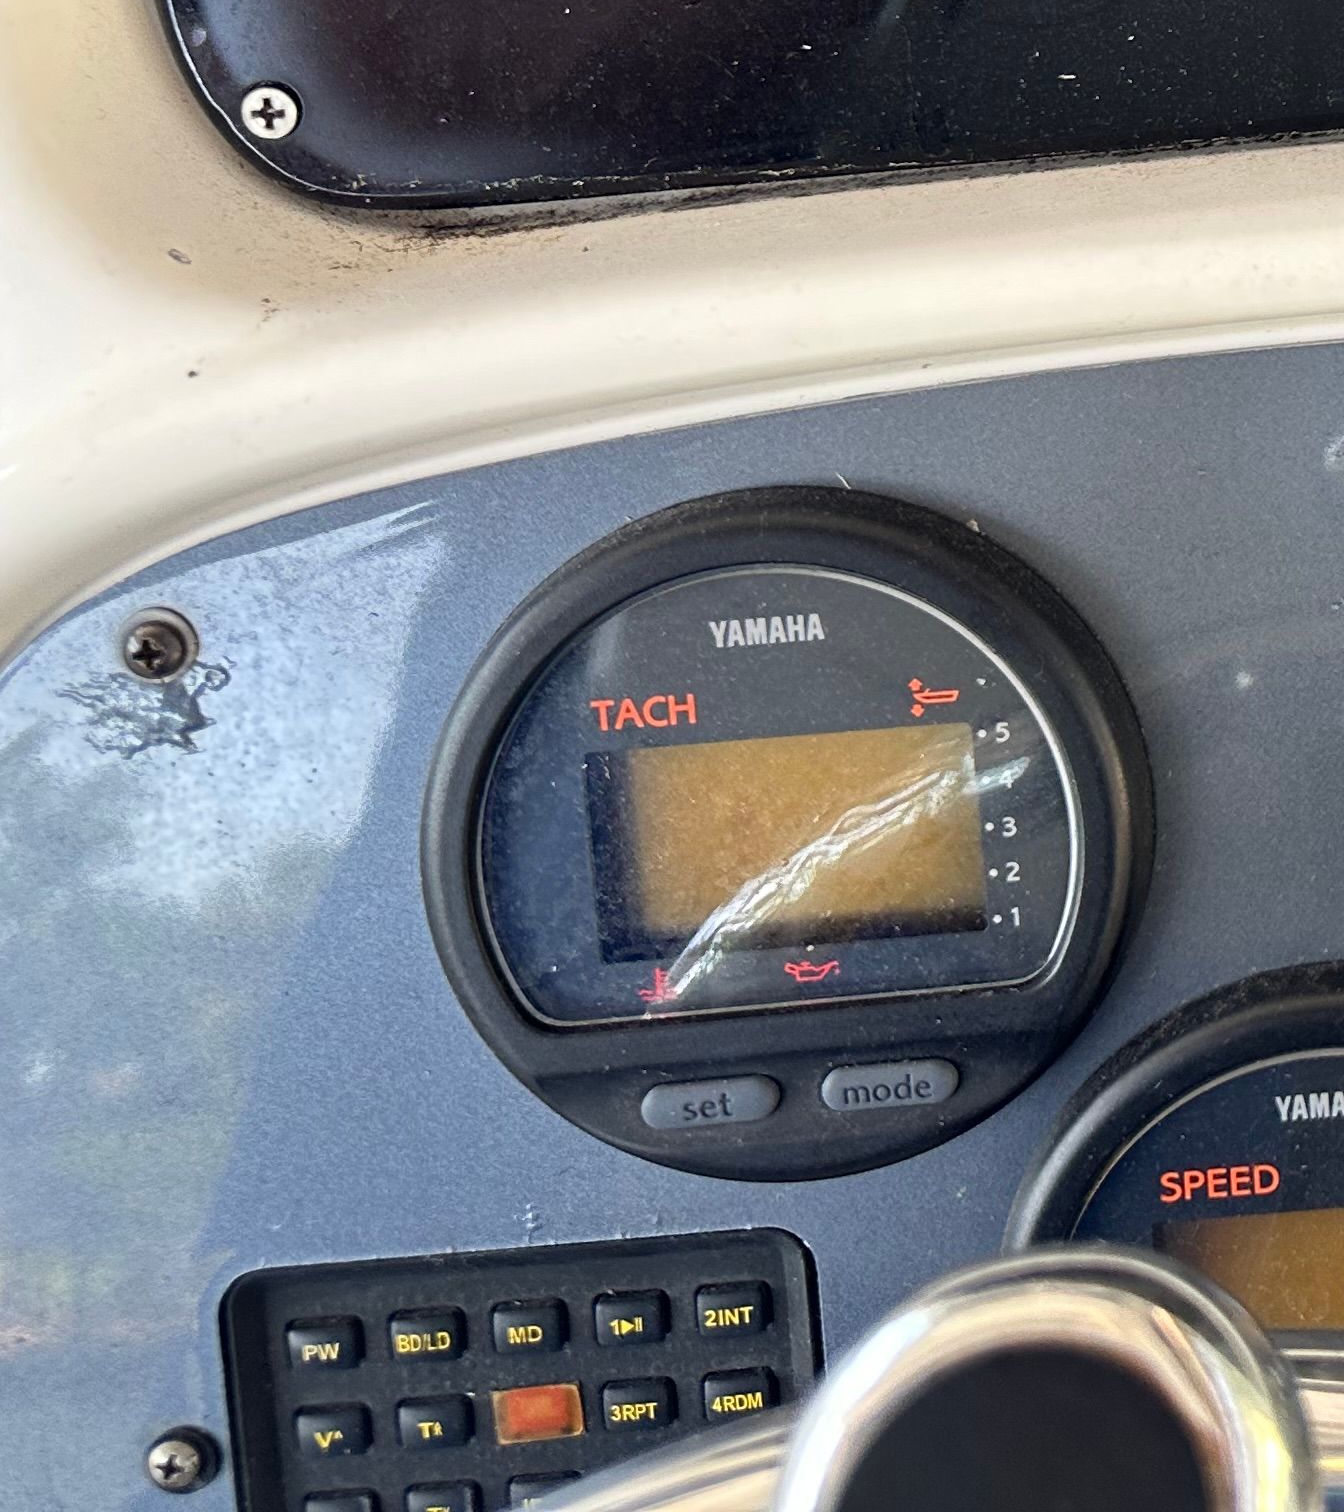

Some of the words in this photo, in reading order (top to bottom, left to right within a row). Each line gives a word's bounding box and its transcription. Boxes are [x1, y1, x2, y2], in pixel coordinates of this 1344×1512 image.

[708, 613, 825, 648] YAMAHA
[589, 693, 697, 732] TACH
[995, 722, 1010, 743] 5
[1002, 816, 1018, 838] 3
[1005, 861, 1020, 882] 2
[1011, 907, 1020, 927] 1
[842, 1073, 933, 1103] mode
[682, 1094, 733, 1120] set
[1159, 1163, 1280, 1203] SPEED
[704, 1305, 754, 1328] 2INT
[507, 1325, 543, 1344] MD
[302, 1342, 340, 1362] PW
[611, 1402, 658, 1422] 3RPT
[712, 1391, 763, 1413] 4RDM
